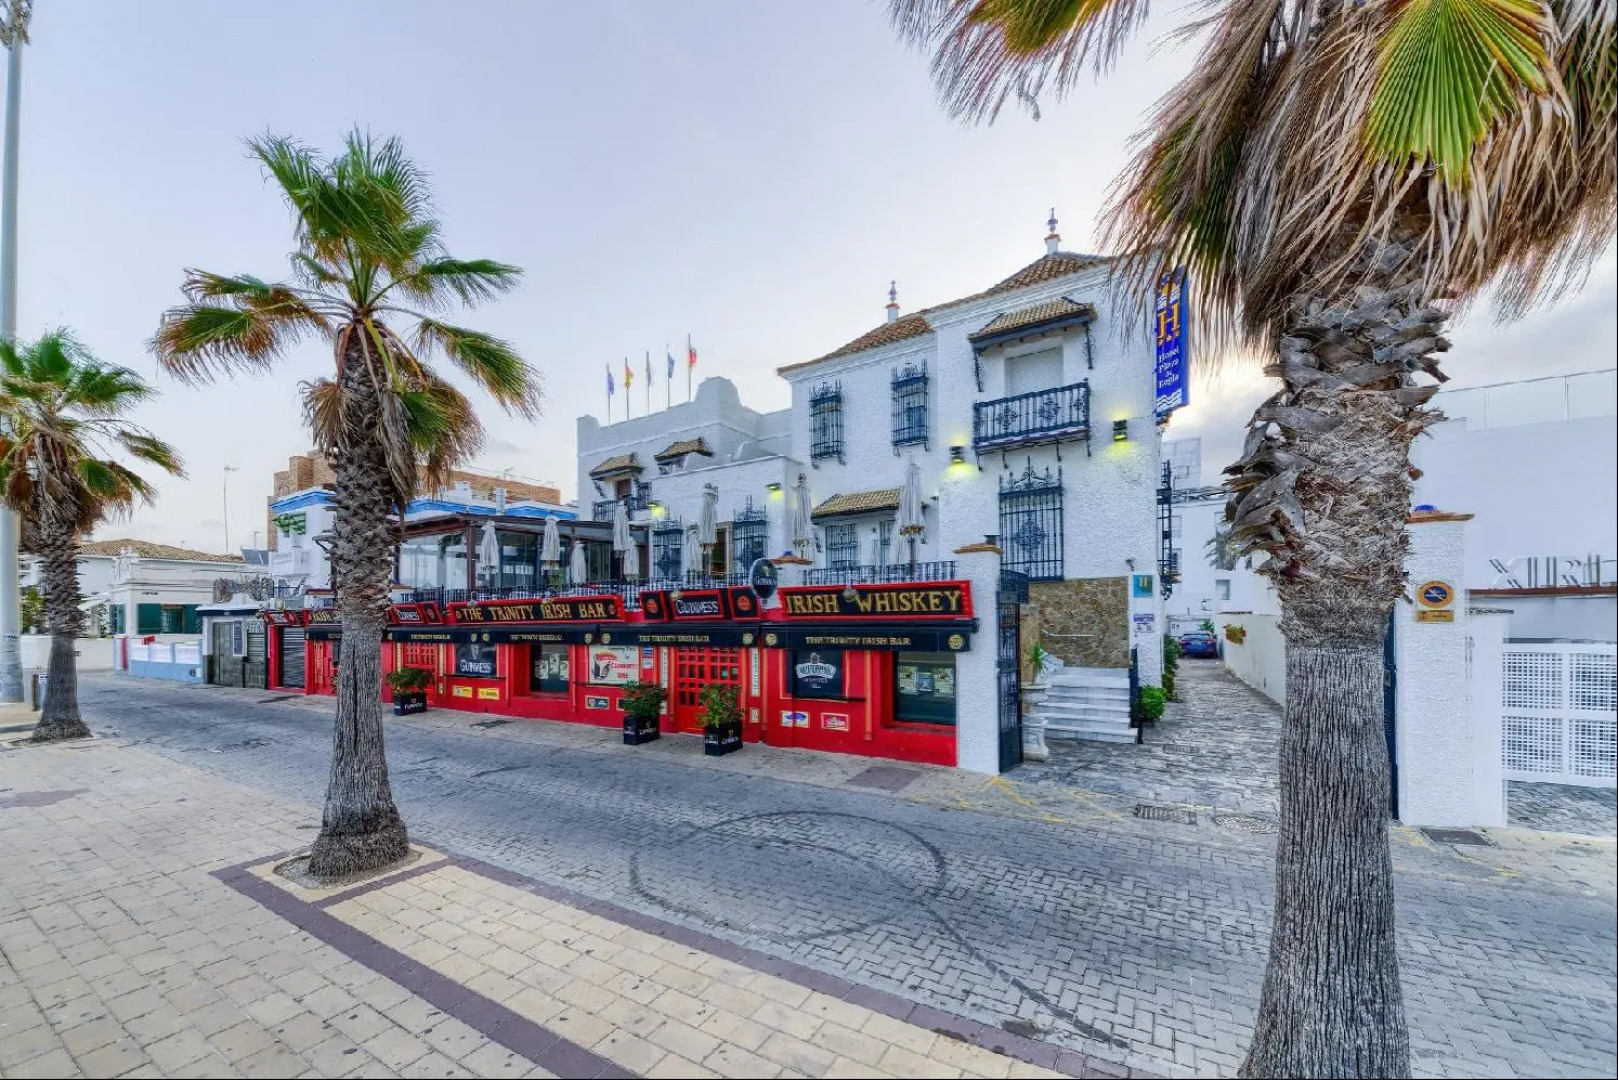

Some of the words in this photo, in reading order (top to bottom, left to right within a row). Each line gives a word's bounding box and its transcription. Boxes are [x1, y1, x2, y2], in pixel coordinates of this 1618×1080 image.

[1158, 346, 1179, 363] Hotel
[1158, 374, 1179, 389] Regla
[786, 594, 841, 614] IRISH
[854, 590, 962, 612] WHISKEY
[462, 608, 484, 621] THE
[488, 605, 535, 621] TRINITY
[540, 603, 572, 620] IRISH
[578, 602, 606, 619] BAR
[825, 637, 860, 646] TRINITY
[889, 638, 912, 646] BAR
[460, 659, 492, 674] GUINNESS
